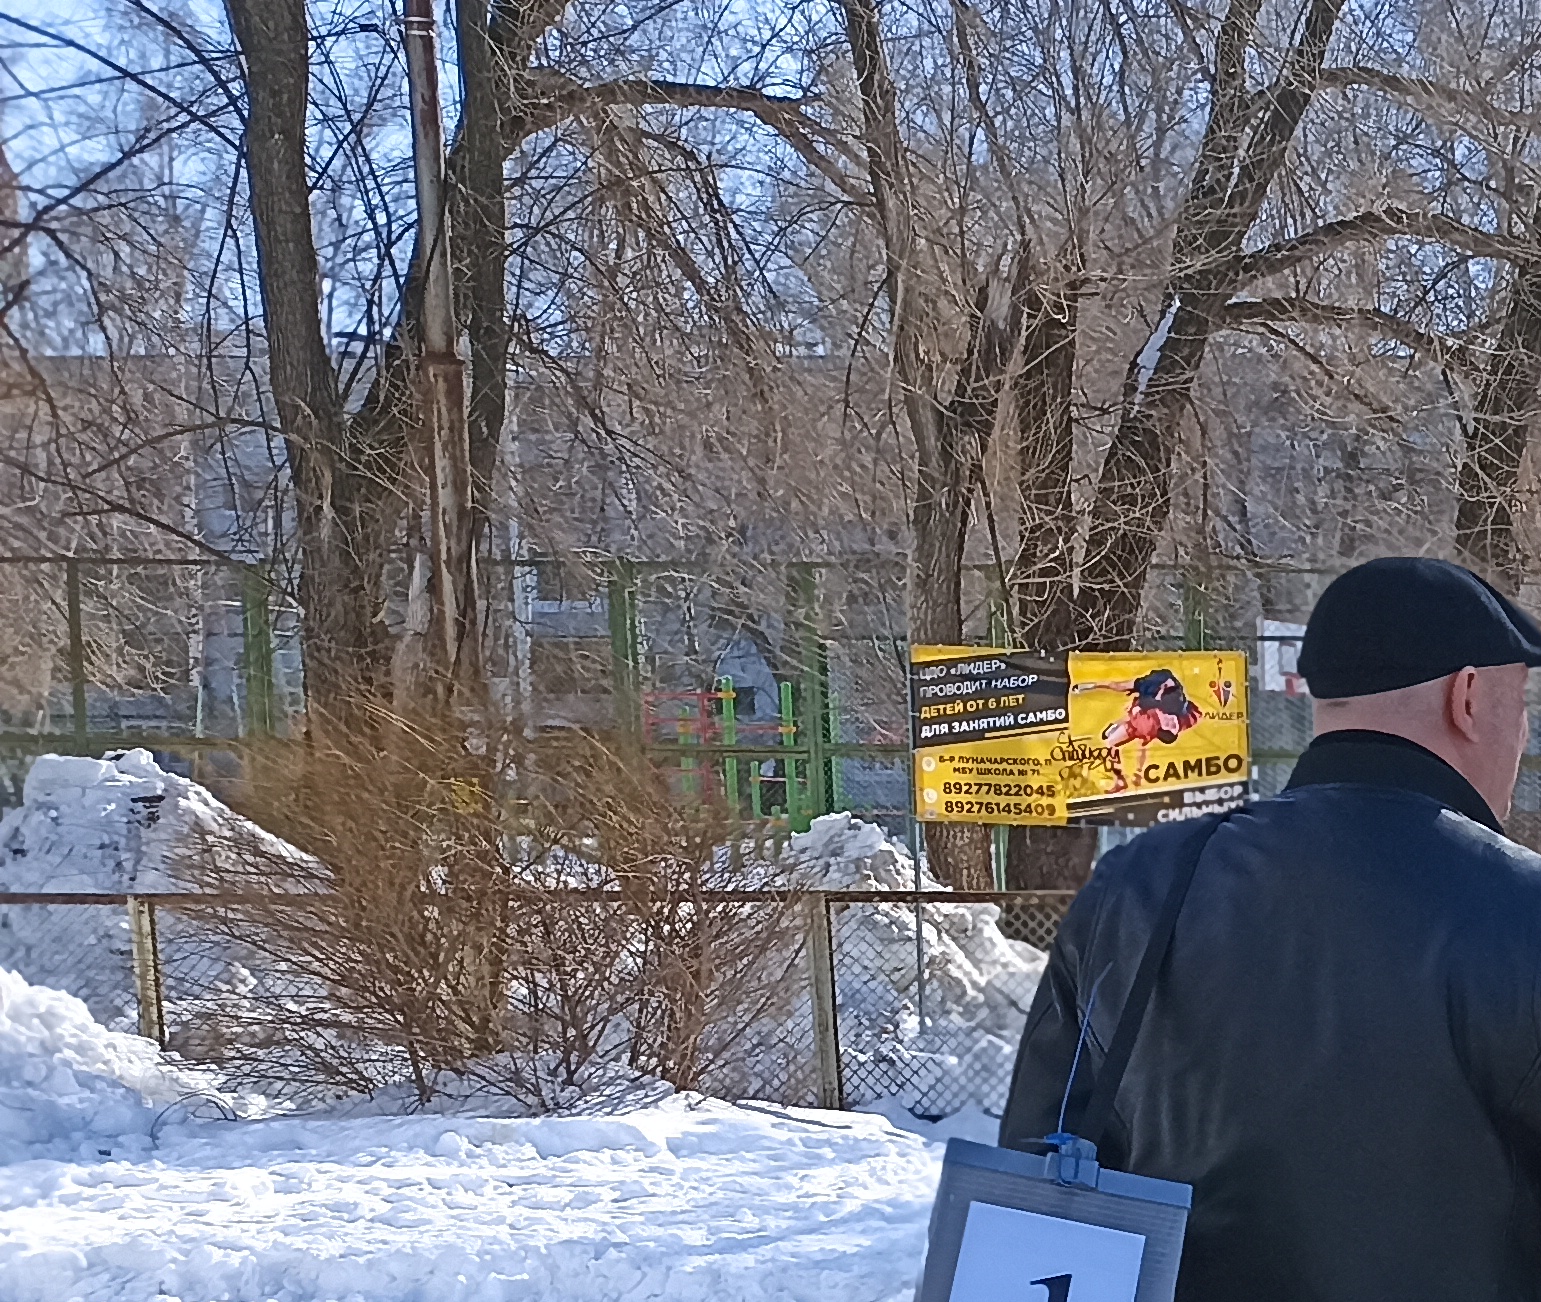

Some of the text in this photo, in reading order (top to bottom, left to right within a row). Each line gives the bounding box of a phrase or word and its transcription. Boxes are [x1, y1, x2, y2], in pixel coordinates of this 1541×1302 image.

[919, 660, 1007, 680] ЦДО «ЛИДЕР»
[920, 674, 1038, 698] ПРОВОДИТ НАБОР
[920, 694, 1025, 719] ДЕТЕЙ ОТ 6 ЛЕТ
[1203, 711, 1244, 721] ЛИДЕР
[920, 708, 1066, 738] ДЛЯ ЗАНЯТИЙ САМБО
[953, 767, 974, 775] МБУ
[975, 767, 1015, 776] ШКОЛА
[1143, 753, 1243, 784] САМБО
[943, 781, 1056, 798] 89277822045
[1183, 785, 1243, 804] ВЫБОР
[944, 800, 1057, 817] 89276145409
